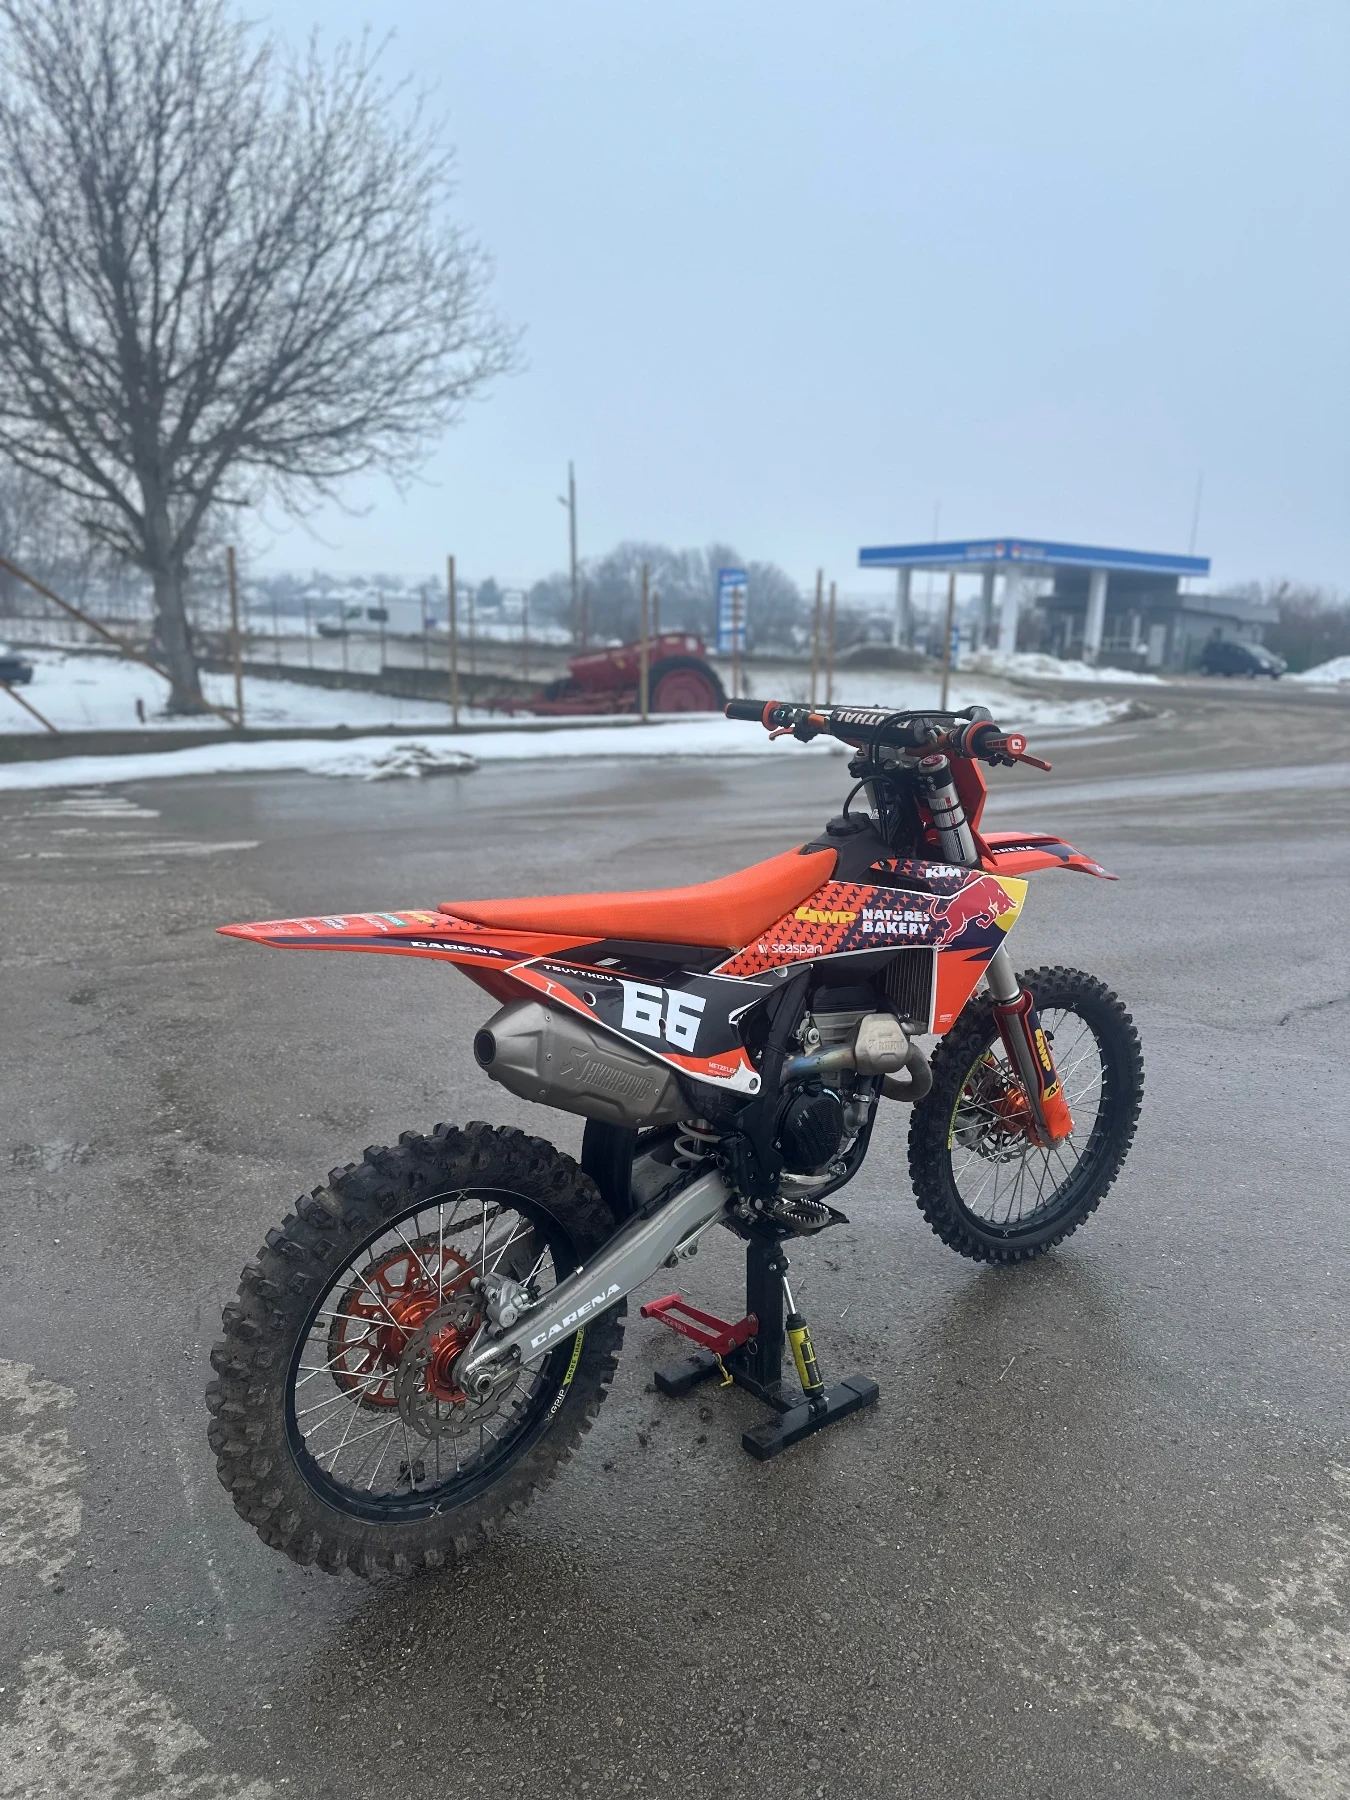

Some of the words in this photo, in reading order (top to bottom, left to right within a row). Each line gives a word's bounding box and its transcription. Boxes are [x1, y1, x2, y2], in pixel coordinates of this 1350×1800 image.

[926, 865, 961, 878] KTM
[862, 921, 930, 934] BAKERY
[410, 941, 503, 956] CARENA
[771, 943, 822, 956] seaspan
[616, 978, 707, 1053] 66
[530, 1283, 621, 1349] CARENA
